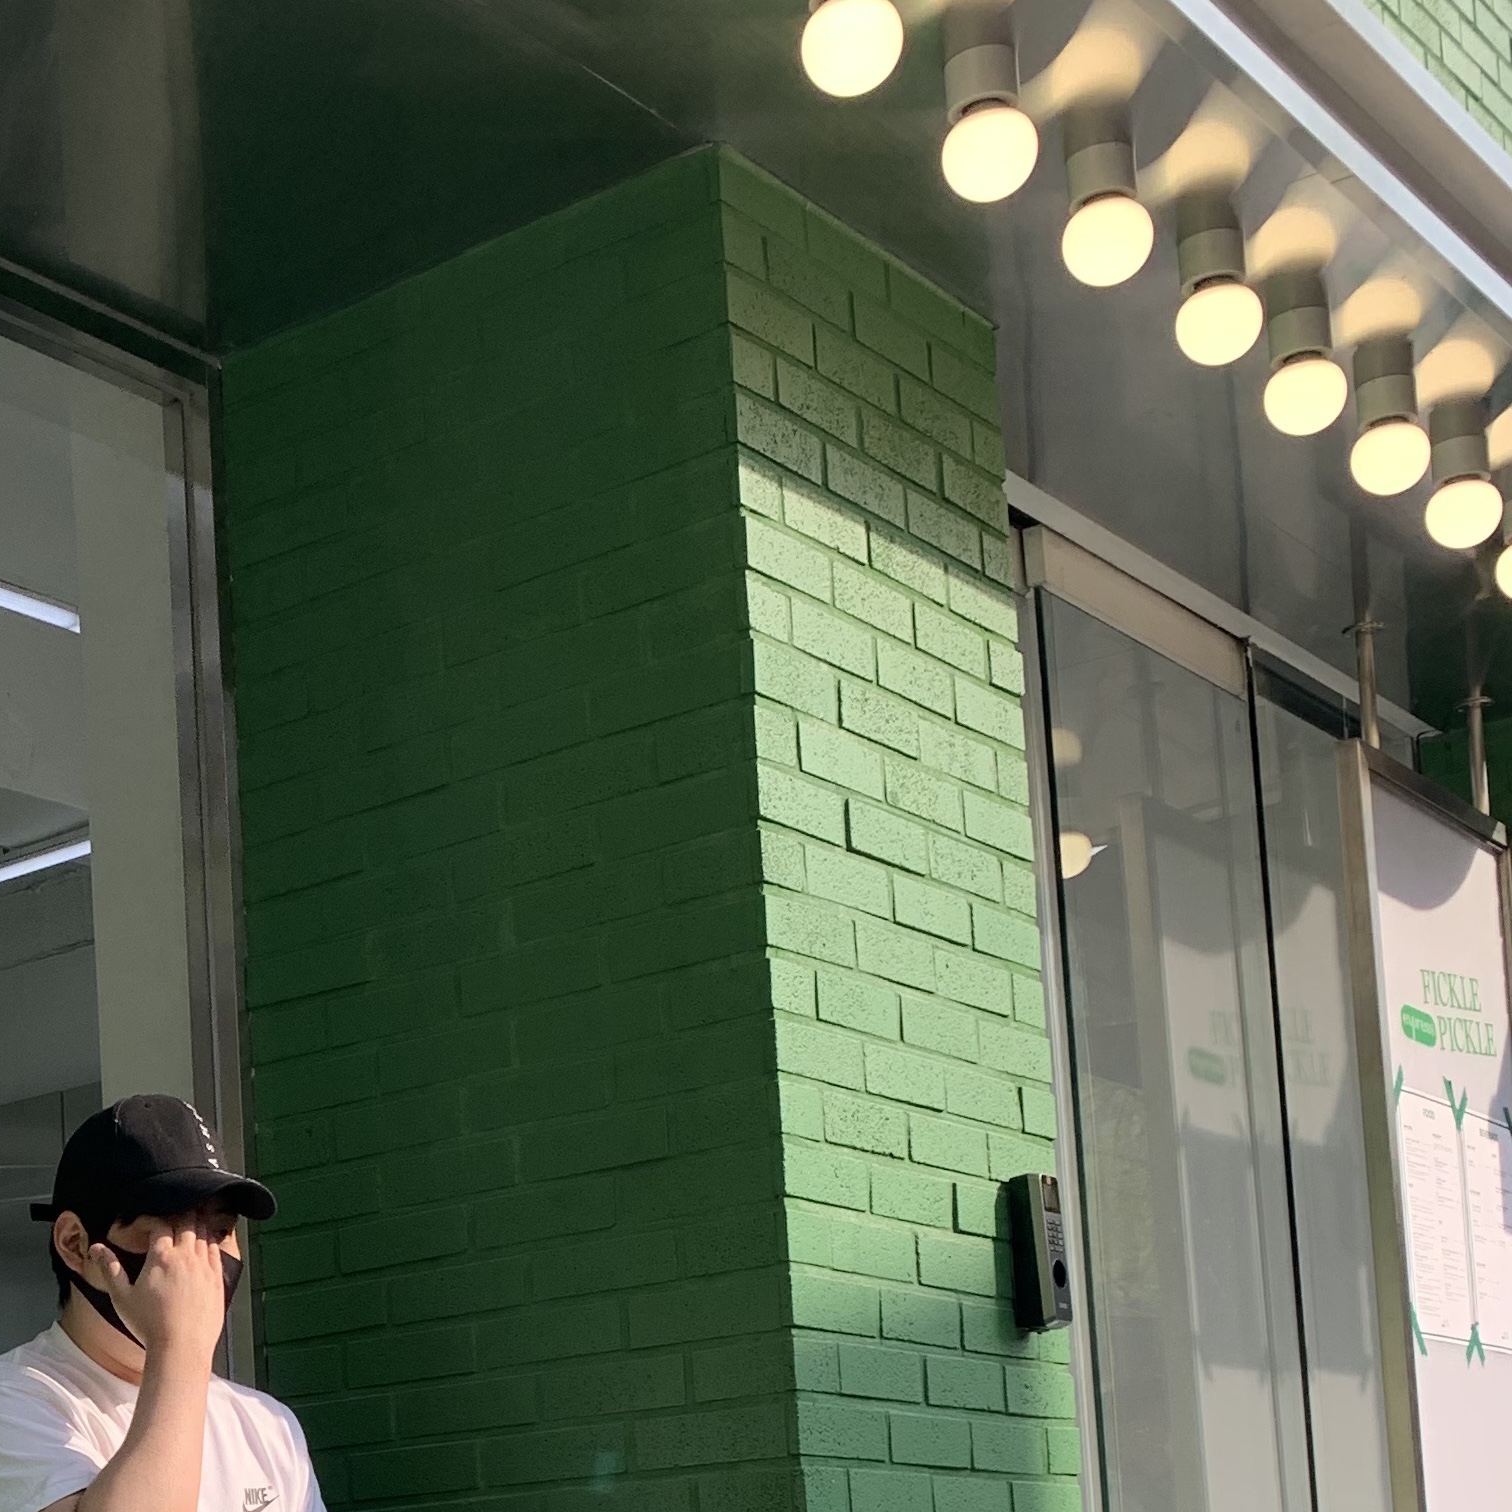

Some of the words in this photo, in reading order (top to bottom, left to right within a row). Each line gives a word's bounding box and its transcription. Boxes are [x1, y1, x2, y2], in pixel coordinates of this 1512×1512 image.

[1420, 969, 1481, 1012] FICKLE
[1436, 1016, 1497, 1057] PICKLE
[244, 1487, 269, 1505] NIKE
